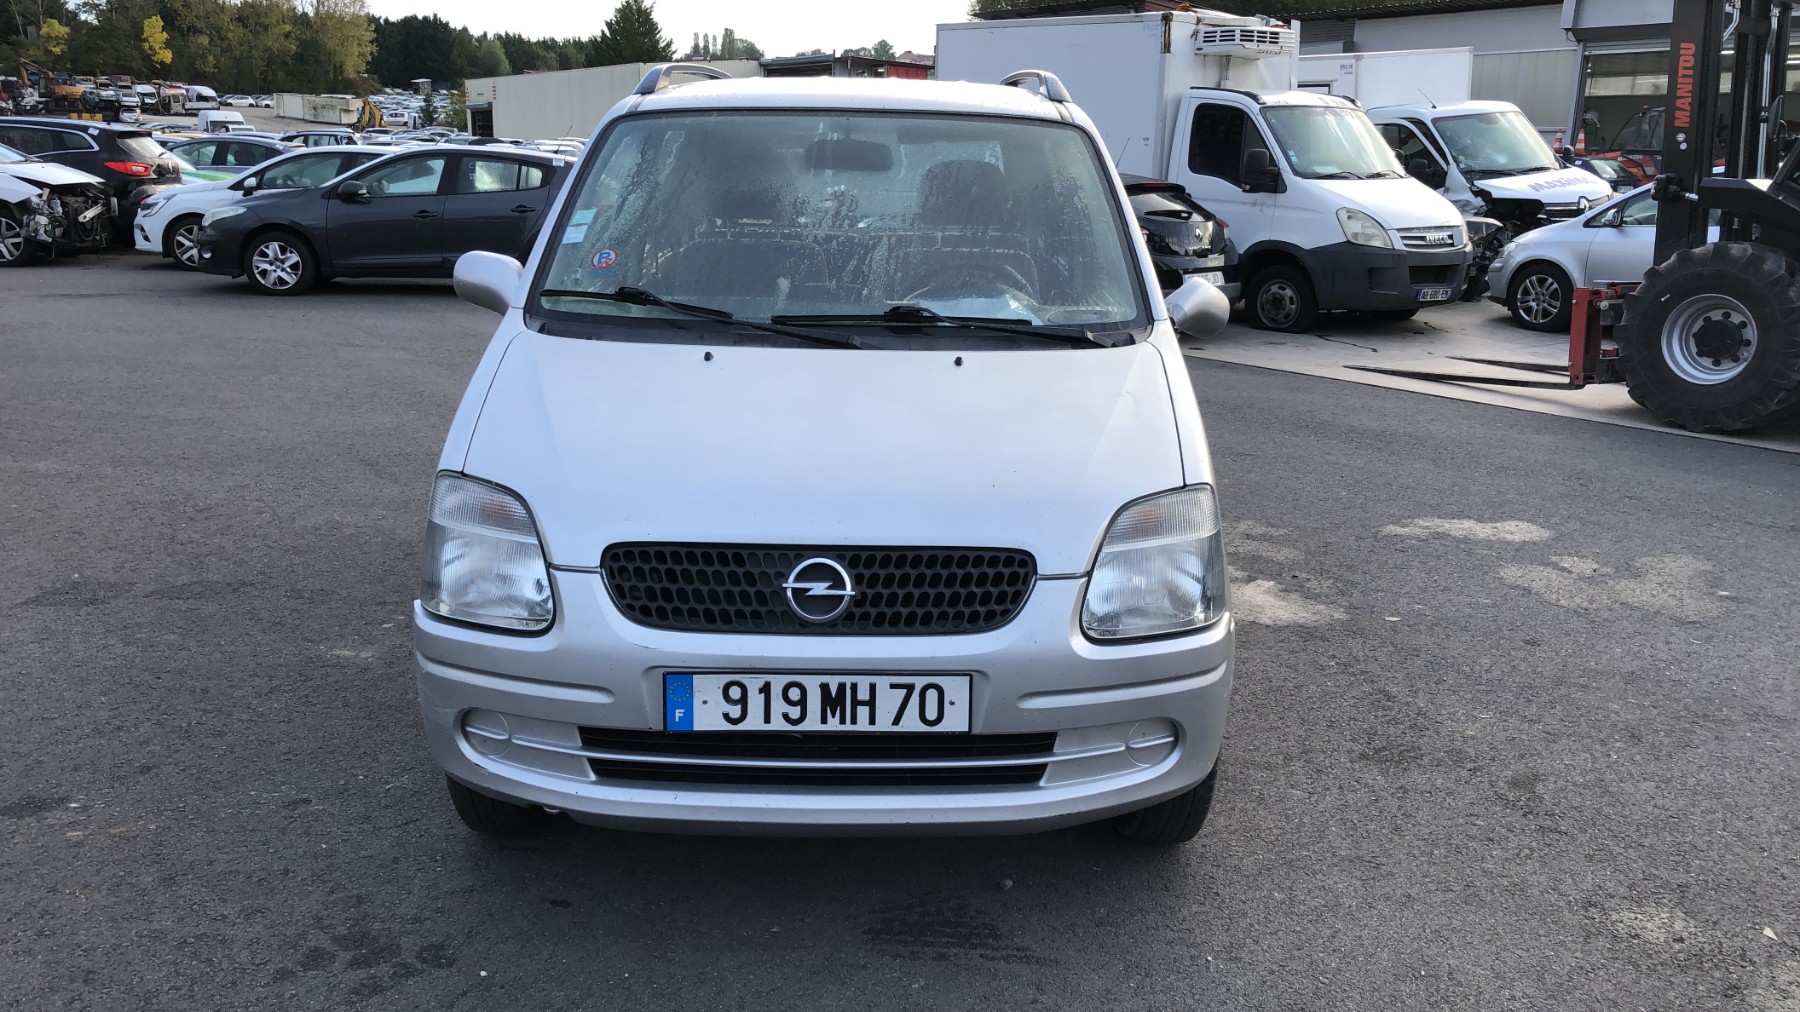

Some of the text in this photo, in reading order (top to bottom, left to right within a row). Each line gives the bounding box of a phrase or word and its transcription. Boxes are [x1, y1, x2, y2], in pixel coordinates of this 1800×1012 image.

[1674, 42, 1696, 128] MANITOU
[1426, 234, 1449, 244] IVECO
[675, 709, 685, 722] F
